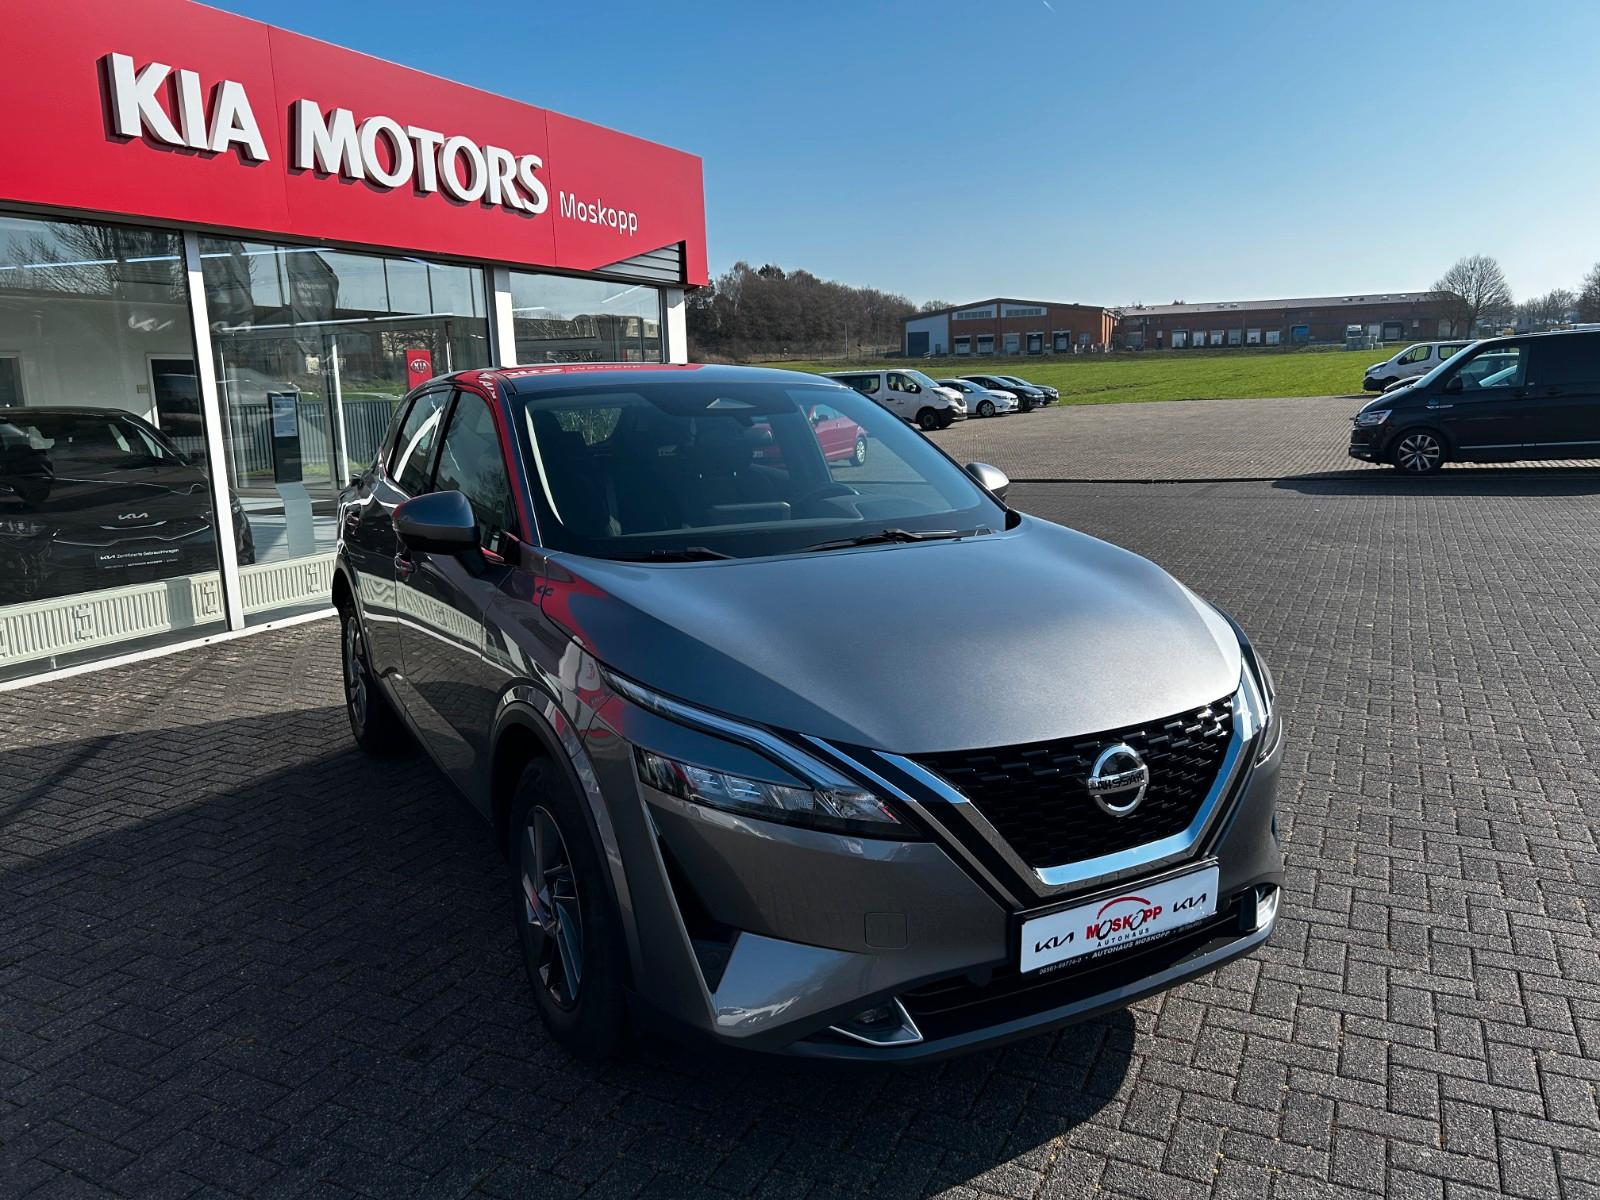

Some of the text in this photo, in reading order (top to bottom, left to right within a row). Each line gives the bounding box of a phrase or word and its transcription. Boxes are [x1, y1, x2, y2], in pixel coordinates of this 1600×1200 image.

[106, 52, 548, 214] KIA MOTORS
[560, 190, 638, 236] Moskopp
[1173, 893, 1207, 912] KIA
[1086, 906, 1162, 940] MOSKOPP
[1035, 931, 1075, 953] KIA
[1091, 942, 1134, 959] AUTOHAUS
[1134, 930, 1171, 946] MOSKOPP
[1097, 928, 1149, 948] AUTOHAUS
